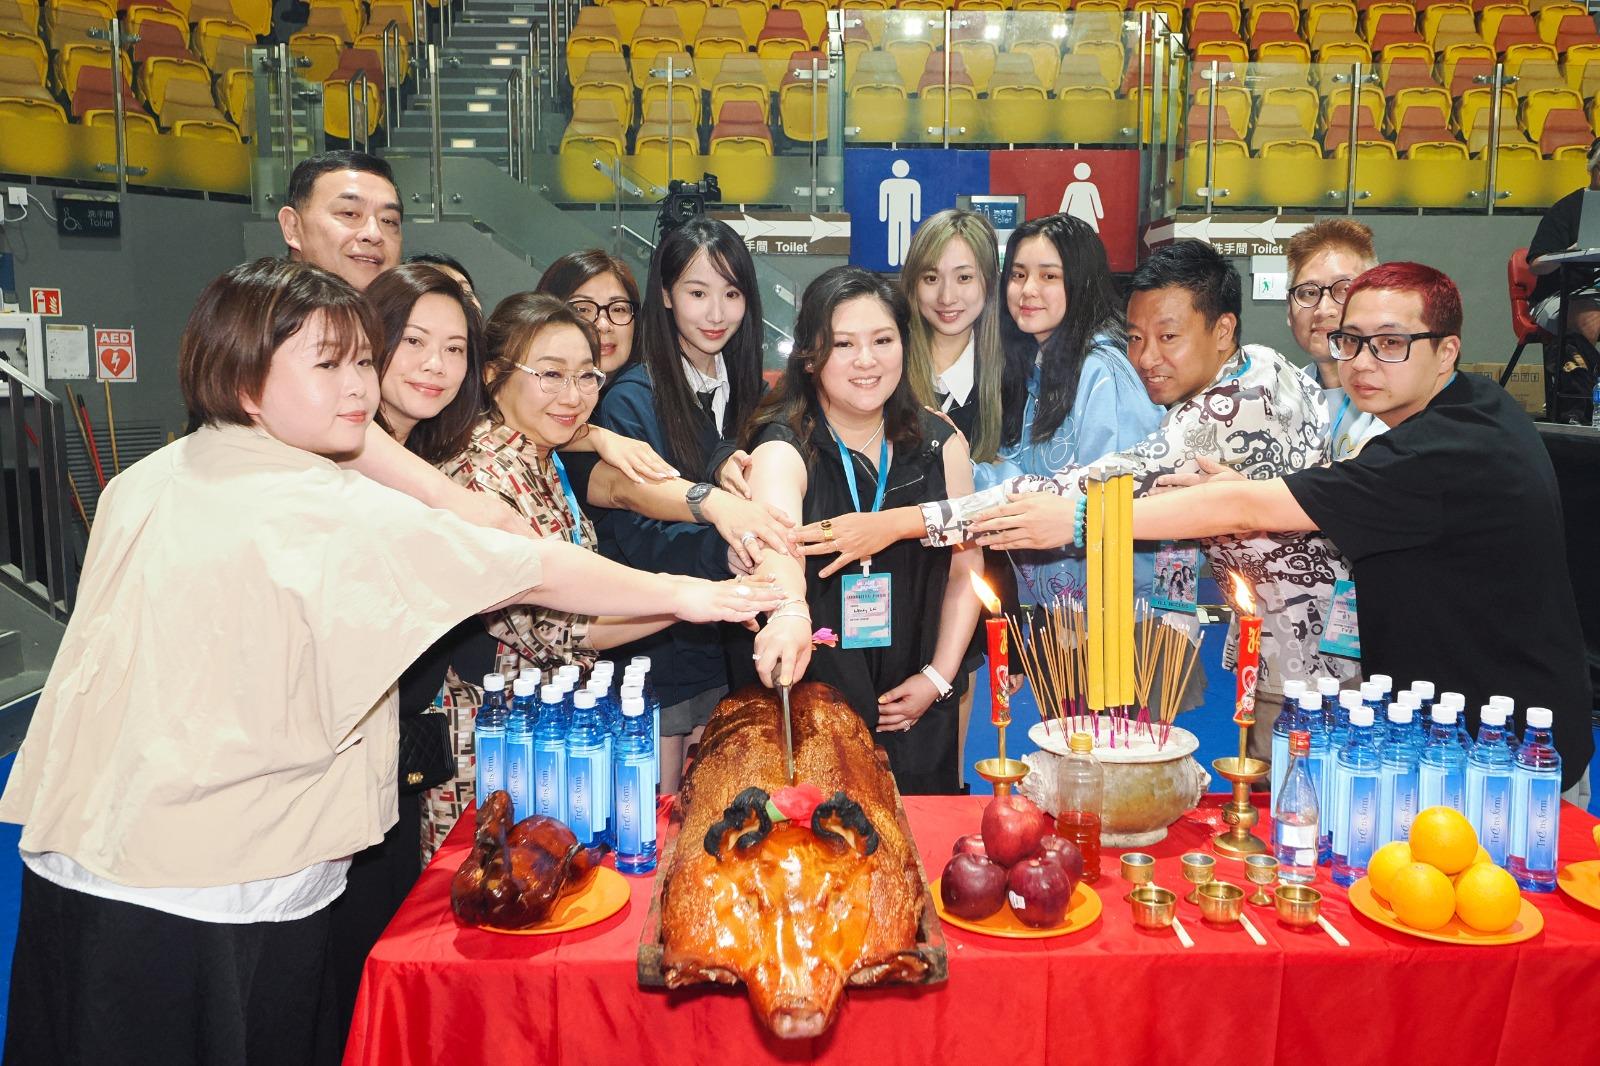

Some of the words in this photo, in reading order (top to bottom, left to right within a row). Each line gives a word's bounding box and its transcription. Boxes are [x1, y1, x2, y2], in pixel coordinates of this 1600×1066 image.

[775, 241, 808, 253] Toilet
[1212, 242, 1247, 255] 洗手間
[1252, 243, 1283, 255] Toilet
[100, 332, 129, 344] AED
